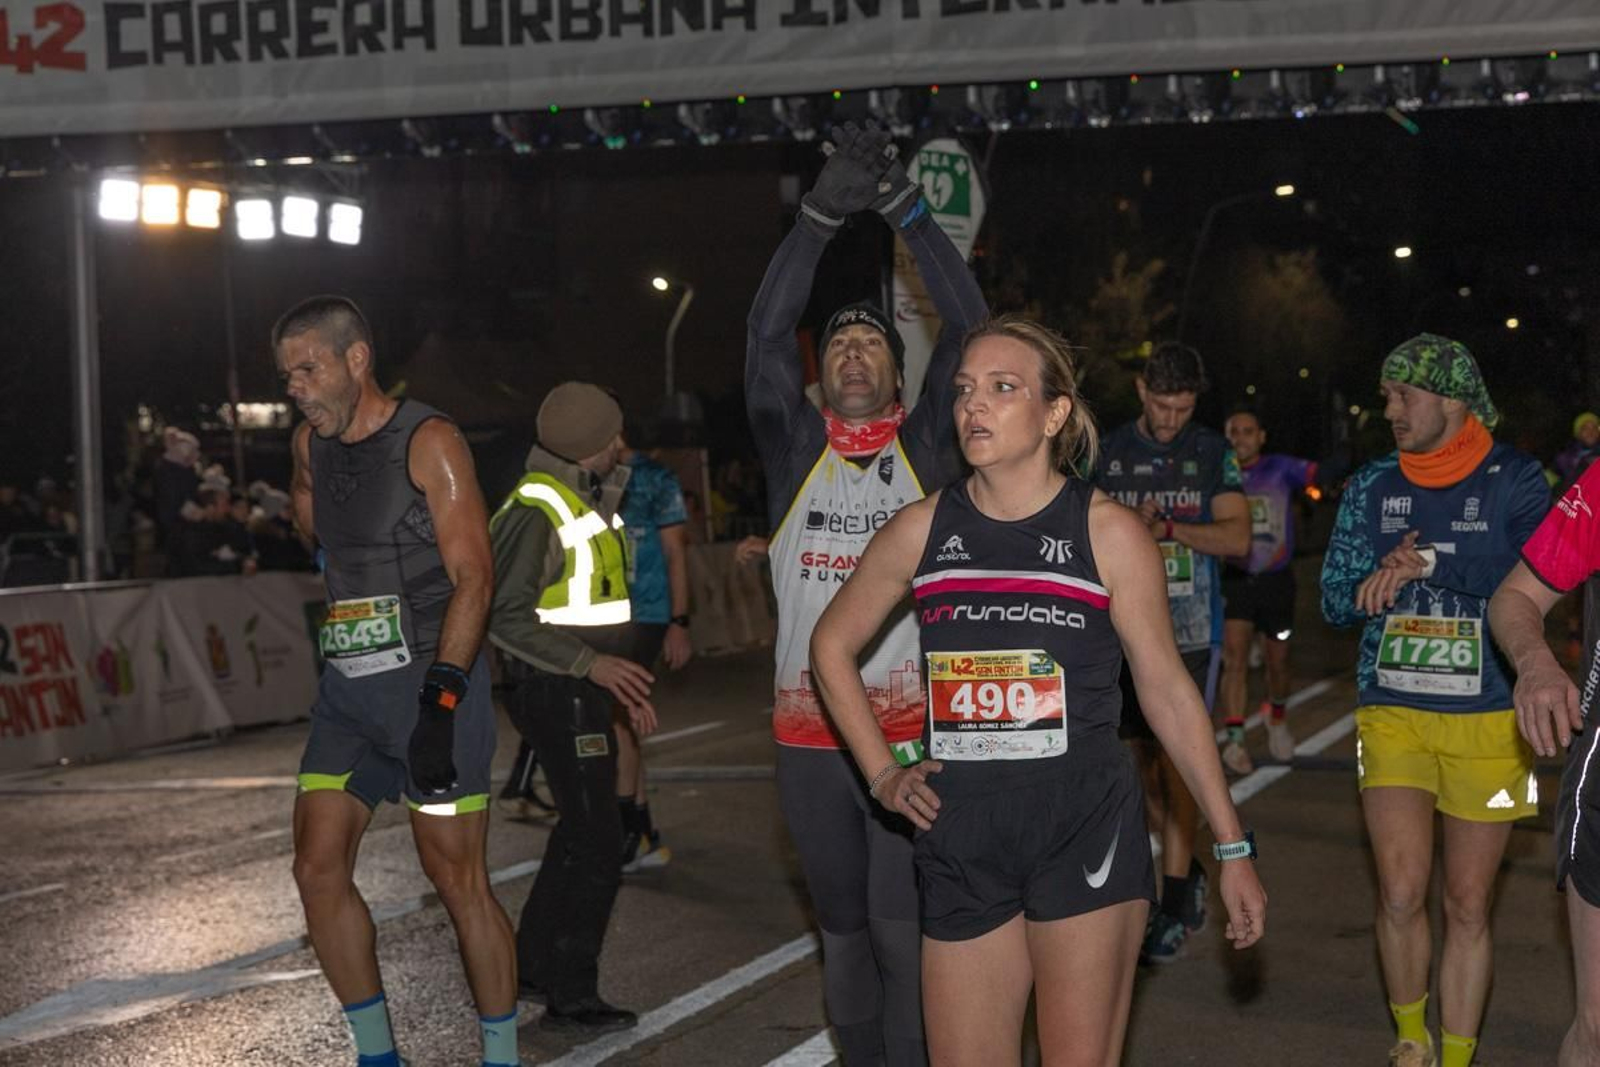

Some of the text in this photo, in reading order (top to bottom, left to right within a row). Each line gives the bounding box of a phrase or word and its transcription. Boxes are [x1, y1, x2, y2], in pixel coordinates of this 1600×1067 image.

[106, 0, 436, 70] CARRERA
[920, 152, 950, 167] DEA
[1450, 521, 1489, 532] SEGOVIA
[319, 617, 392, 652] 2649
[1388, 636, 1473, 667] 1726
[949, 682, 1035, 720] 490
